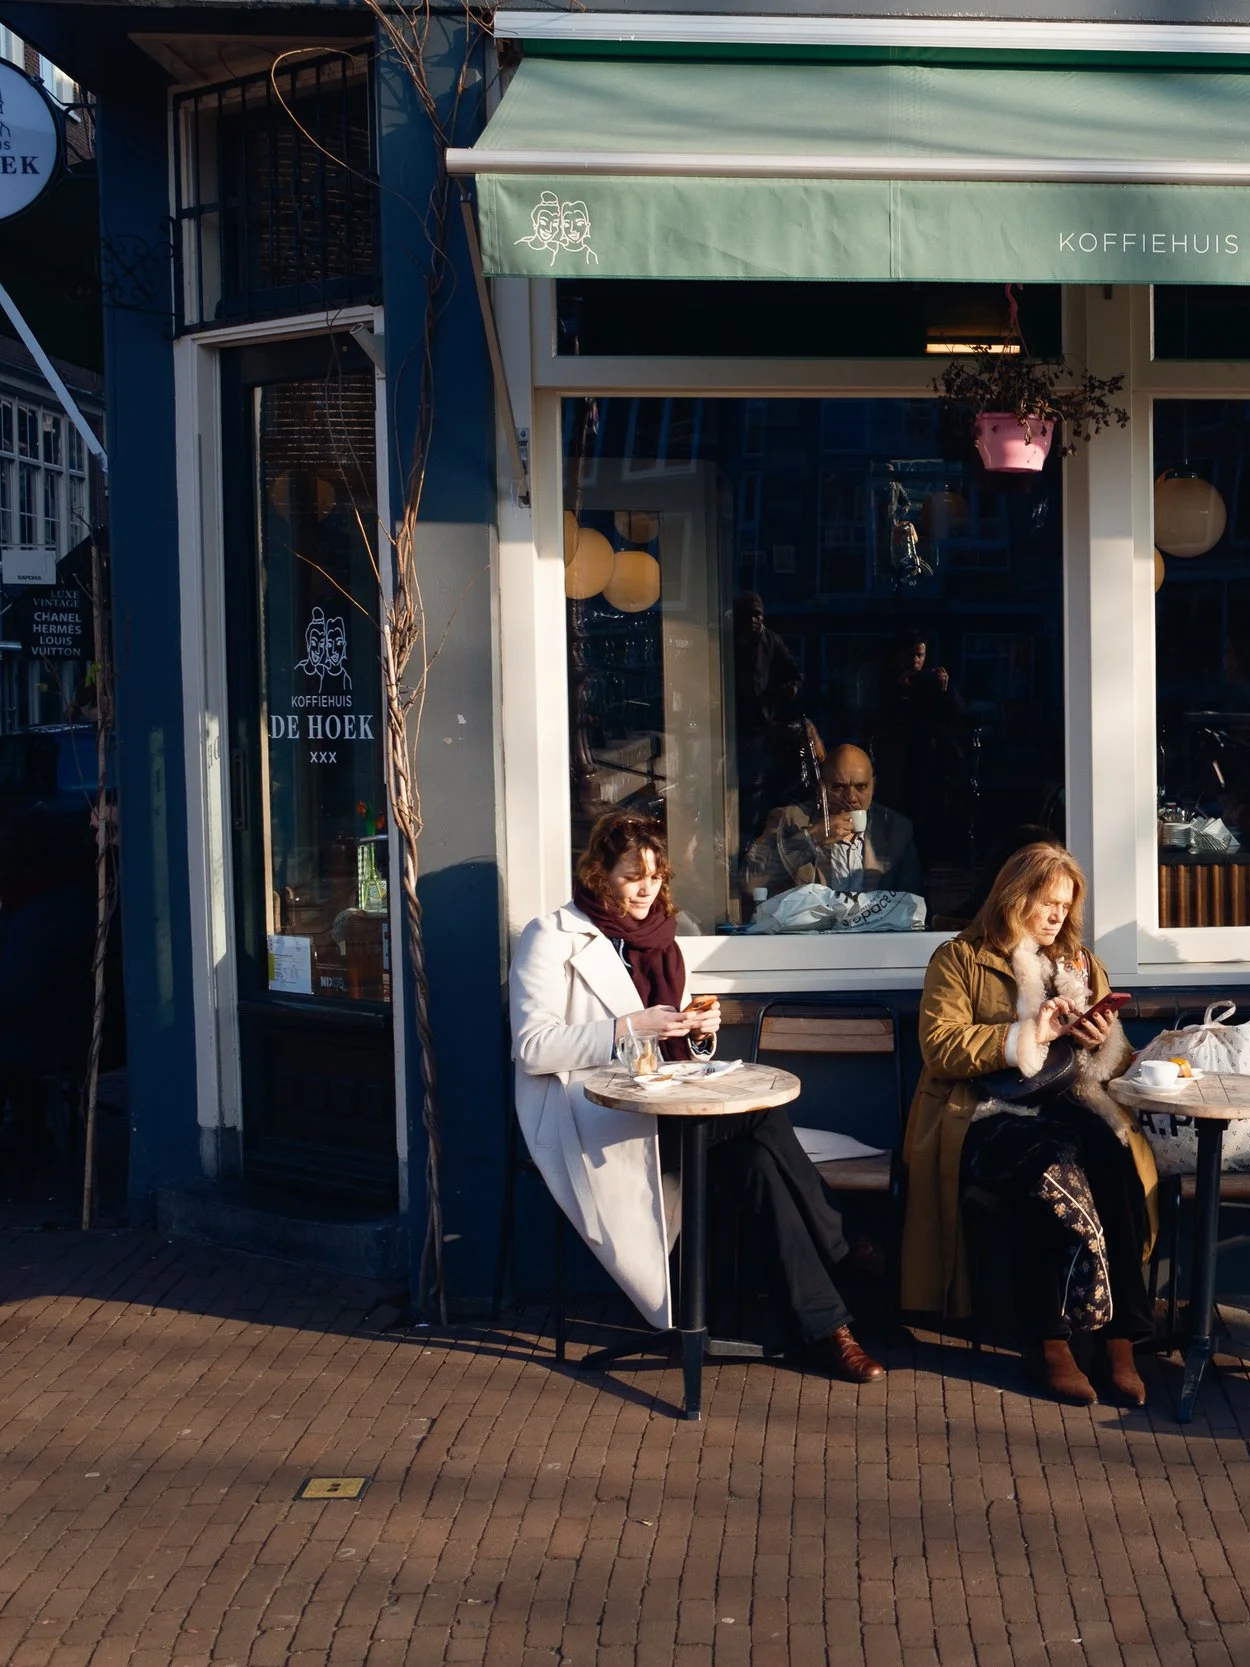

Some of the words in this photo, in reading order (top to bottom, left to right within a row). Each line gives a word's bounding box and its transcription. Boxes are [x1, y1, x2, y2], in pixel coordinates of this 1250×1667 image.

[1058, 231, 1239, 255] KOFFIEHUIS
[51, 589, 80, 599] LUXE
[33, 598, 80, 608] VINTAGE
[33, 611, 82, 623] CHANEL
[32, 623, 82, 635] HERMÈS
[40, 636, 72, 646] LOUIS
[31, 646, 81, 657] VUITTON
[291, 695, 353, 708] KOFFIEHUIS
[270, 714, 300, 739] DE
[307, 714, 375, 740] HOEK
